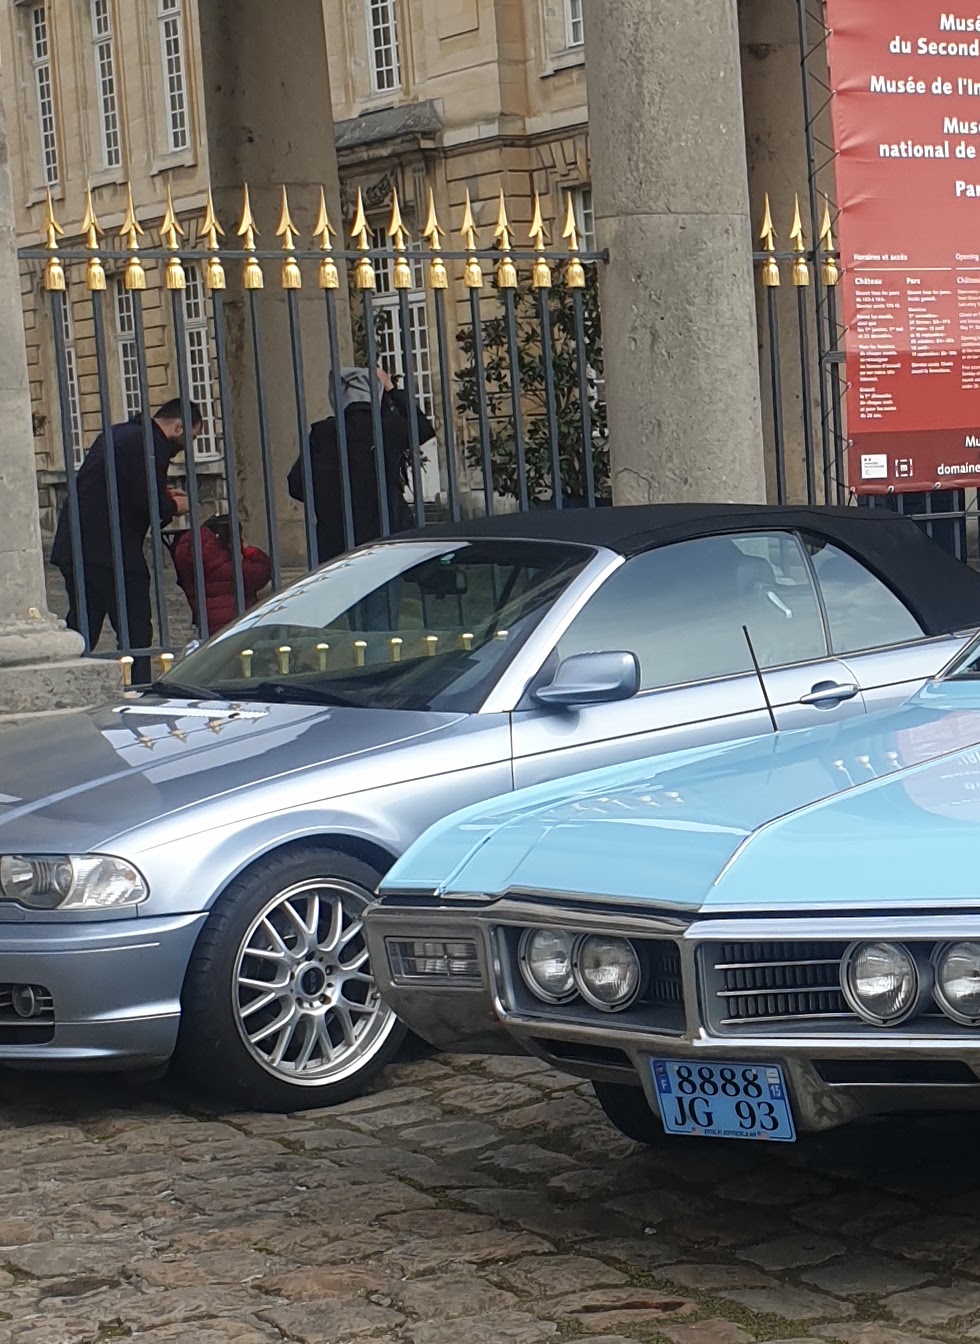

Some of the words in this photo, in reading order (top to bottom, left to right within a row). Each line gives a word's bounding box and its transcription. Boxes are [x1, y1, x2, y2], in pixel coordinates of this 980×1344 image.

[889, 36, 911, 54] du
[917, 37, 979, 57] Second
[870, 75, 926, 94] Musée
[931, 77, 952, 95] de
[879, 140, 950, 158] national
[955, 141, 976, 159] de
[937, 462, 980, 475] domaine
[676, 1065, 763, 1098] 8888
[674, 1096, 714, 1128] JG
[735, 1100, 779, 1131] 93
